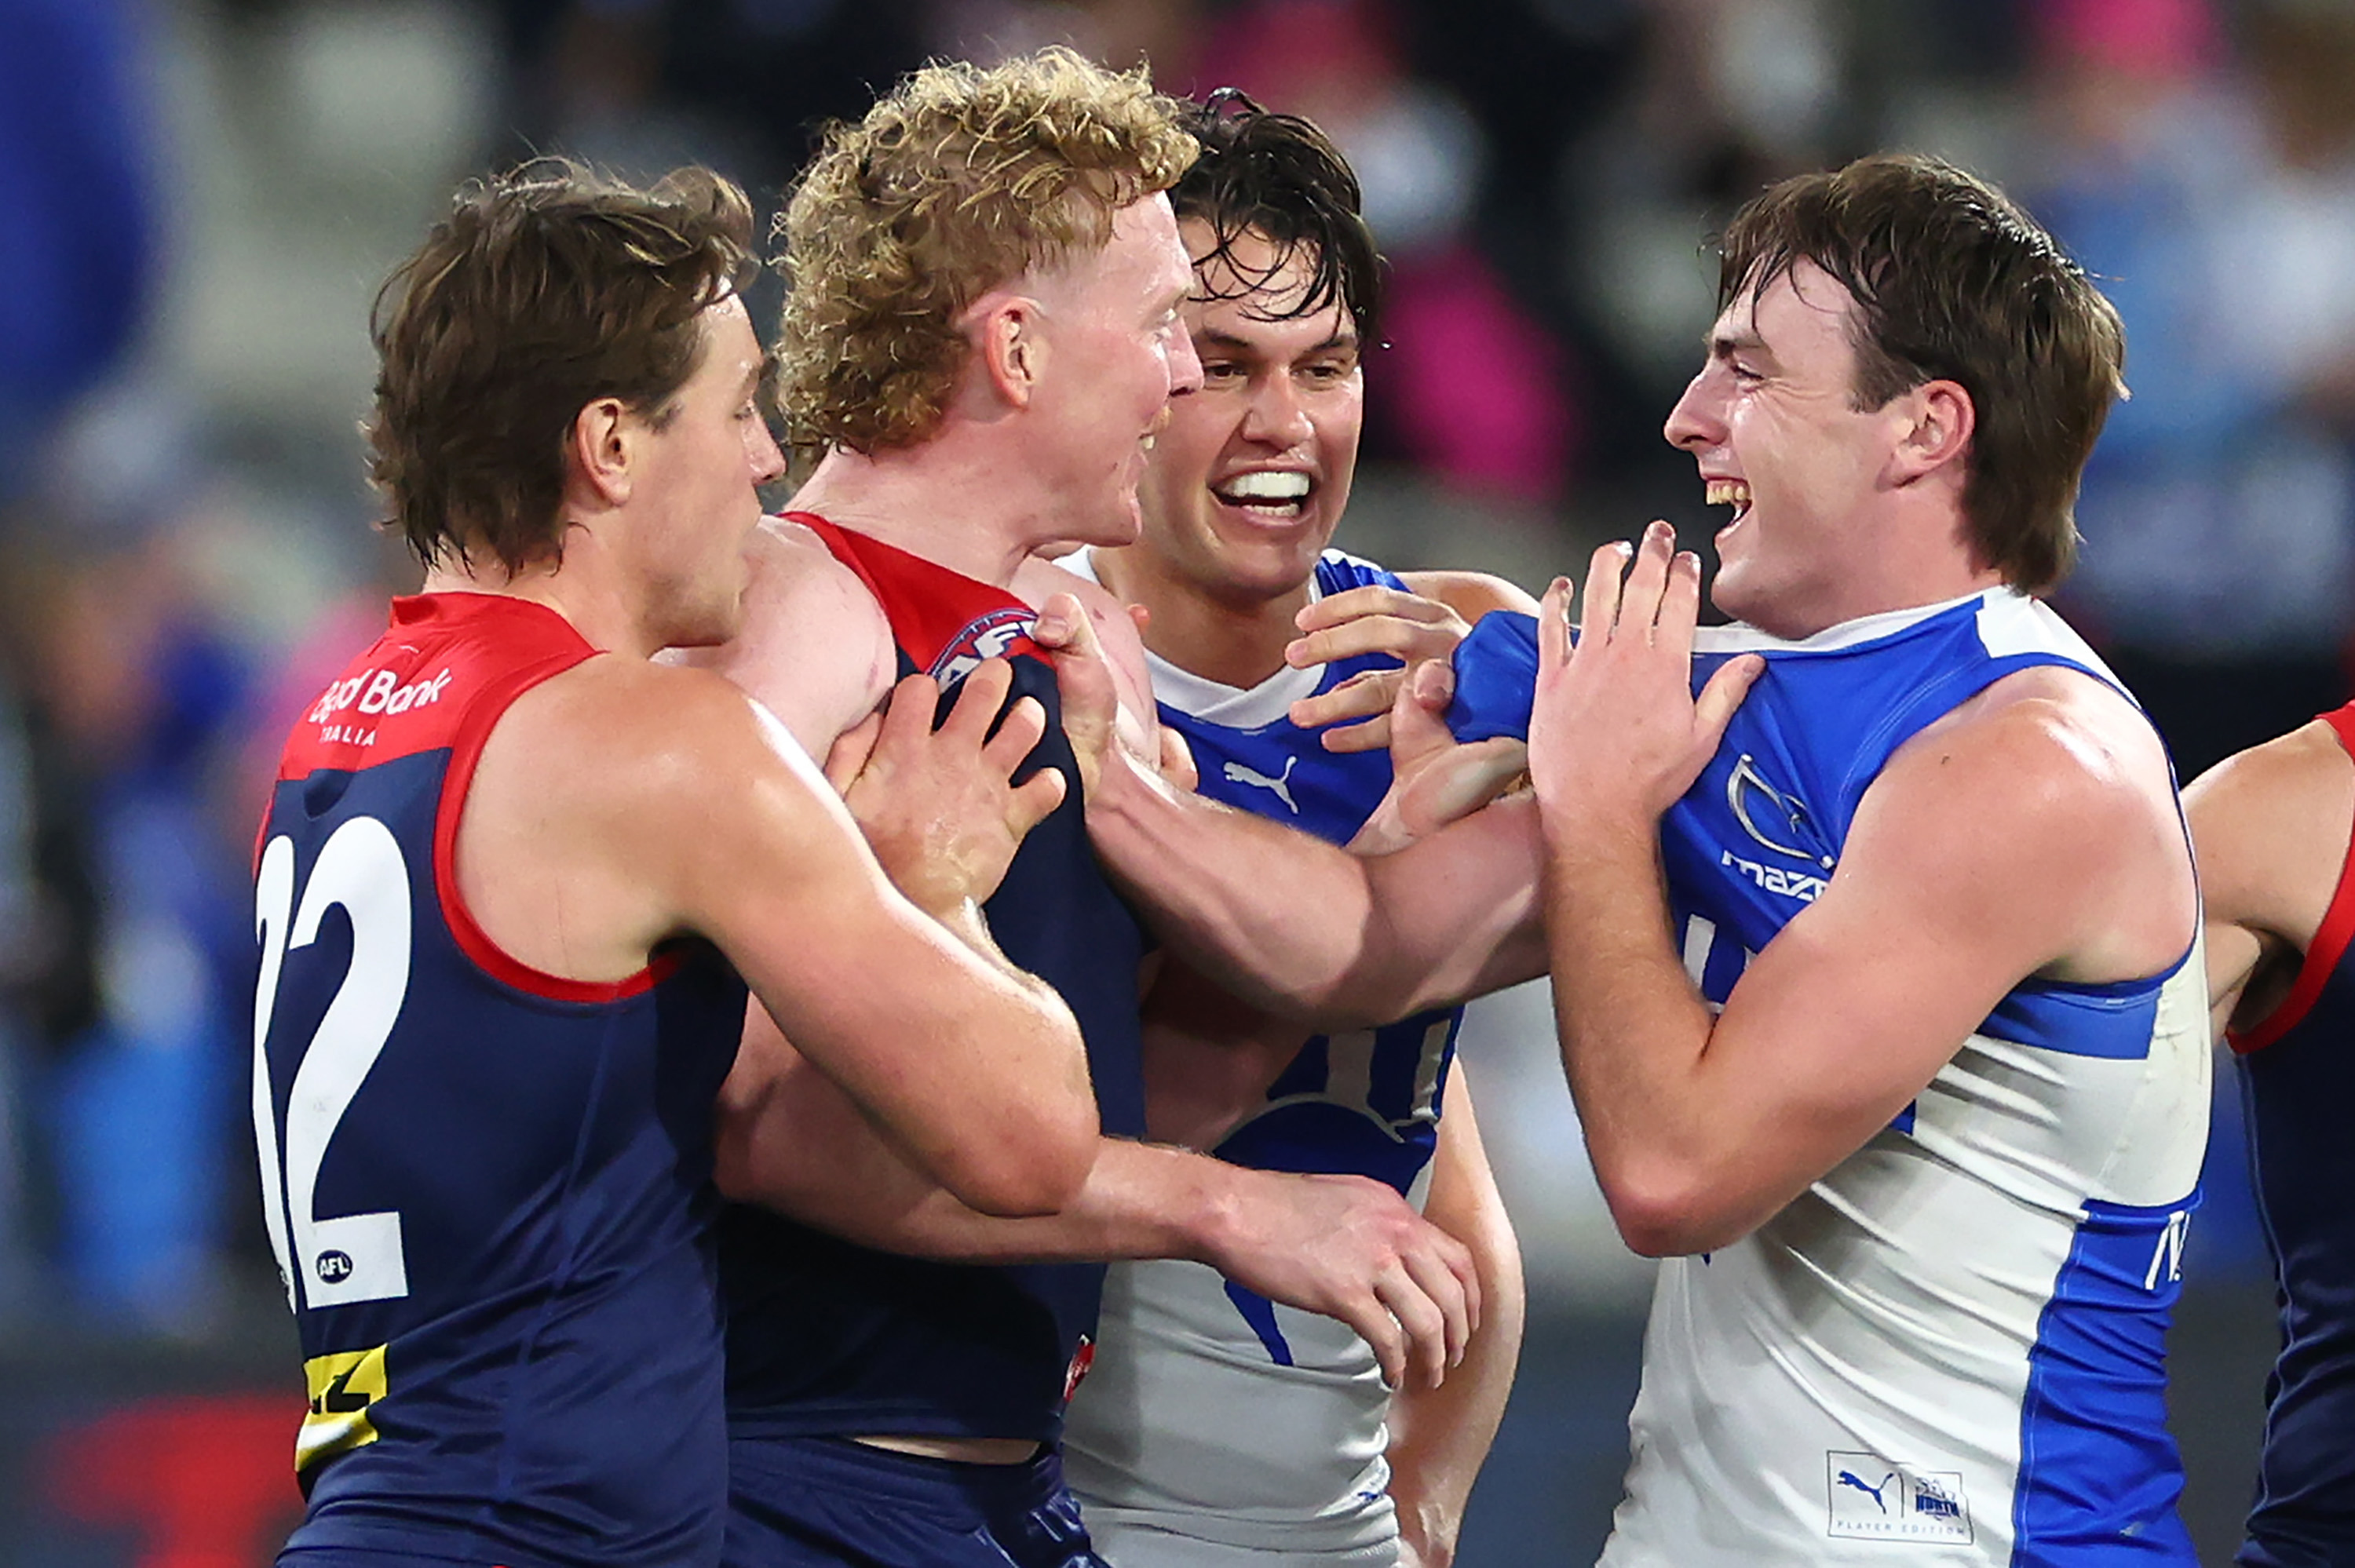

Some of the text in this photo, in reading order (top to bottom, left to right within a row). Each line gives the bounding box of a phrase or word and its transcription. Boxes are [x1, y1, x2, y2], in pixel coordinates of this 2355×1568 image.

[357, 668, 452, 715] Bank
[1722, 850, 1829, 903] maz
[318, 1256, 350, 1277] AFL
[1837, 1520, 1966, 1537] PLAYER EDITION
